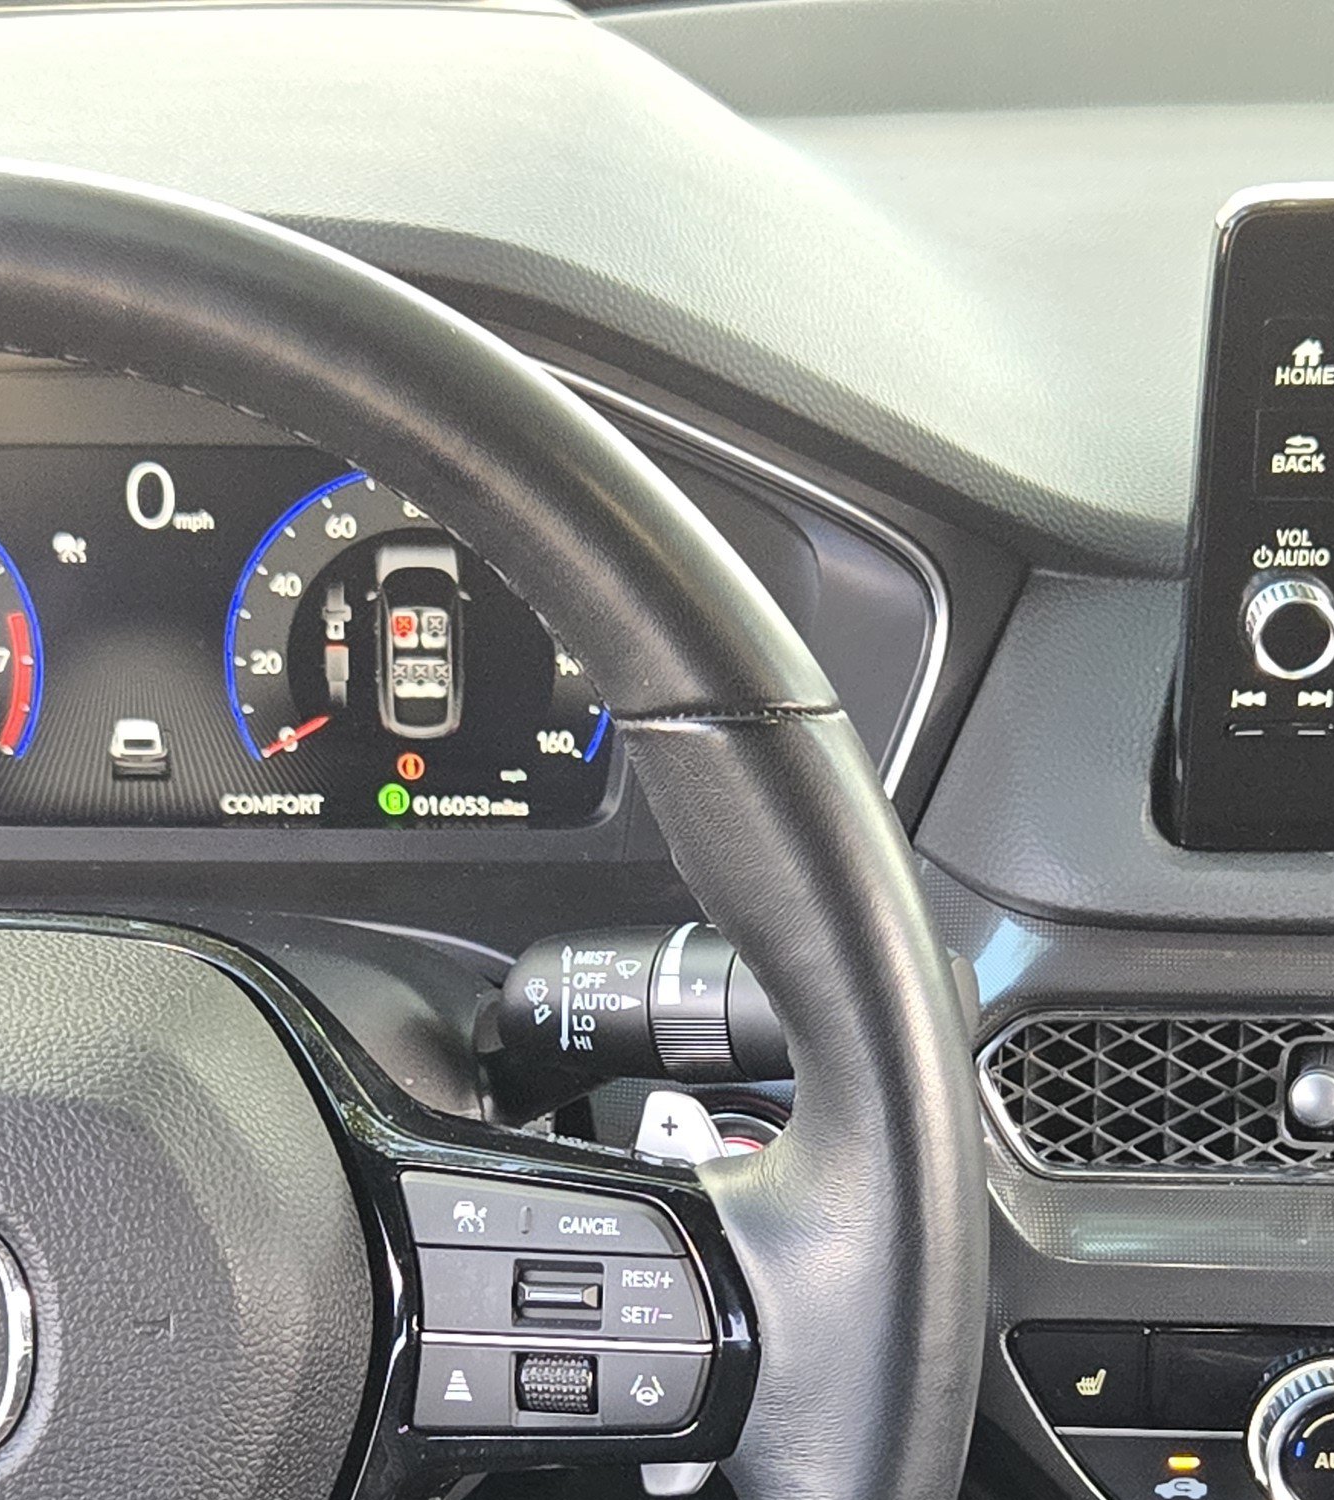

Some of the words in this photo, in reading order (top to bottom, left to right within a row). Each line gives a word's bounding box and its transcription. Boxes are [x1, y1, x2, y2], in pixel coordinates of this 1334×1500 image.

[1271, 454, 1325, 473] BACK
[126, 462, 176, 529] 0
[174, 511, 214, 531] mph
[325, 515, 357, 539] 60
[1276, 529, 1312, 547] VOL
[1274, 548, 1329, 566] AUDIO
[271, 575, 301, 597] 40
[250, 653, 281, 674] 20
[537, 731, 575, 754] 160
[221, 796, 323, 815] COMFORT
[412, 795, 490, 816] 016053
[574, 951, 617, 965] MIST
[573, 973, 606, 988] OFF
[572, 994, 620, 1010] AUTO
[572, 1015, 595, 1031] LO
[573, 1035, 593, 1050] HI
[559, 1217, 620, 1236] CANCEL
